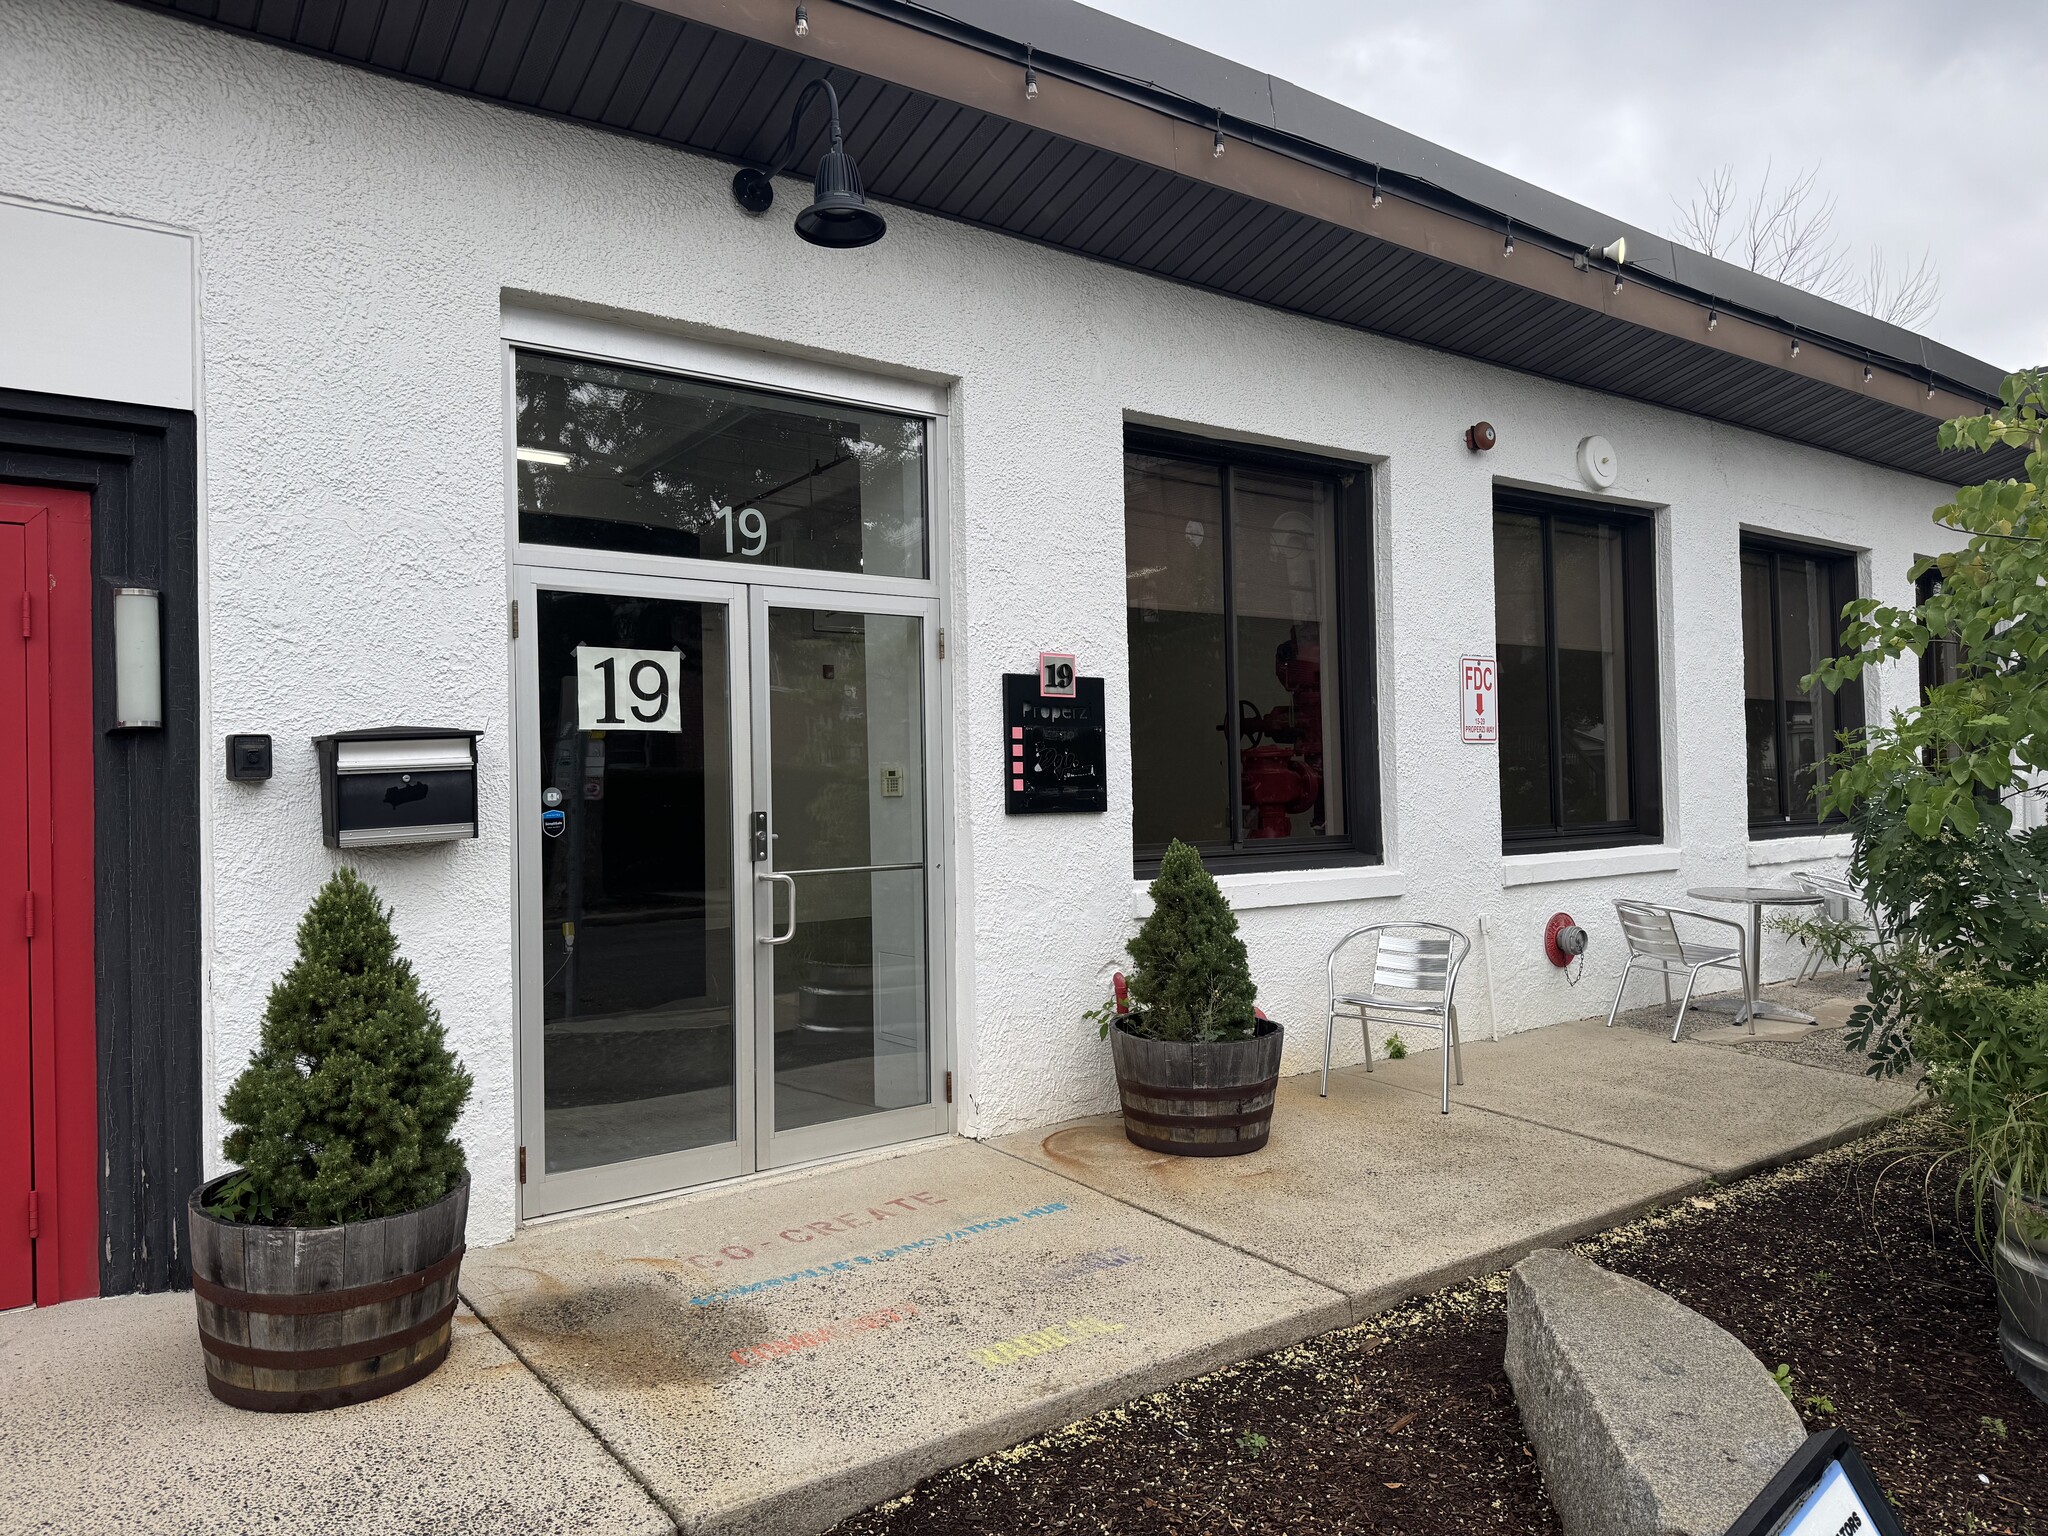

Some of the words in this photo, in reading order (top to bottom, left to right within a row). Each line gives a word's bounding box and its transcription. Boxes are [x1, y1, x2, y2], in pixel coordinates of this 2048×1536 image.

[716, 505, 768, 557] 19
[1044, 663, 1074, 688] 19
[1465, 666, 1492, 691] FDC
[593, 656, 669, 725] 19
[1021, 1201, 1069, 1219] HUB
